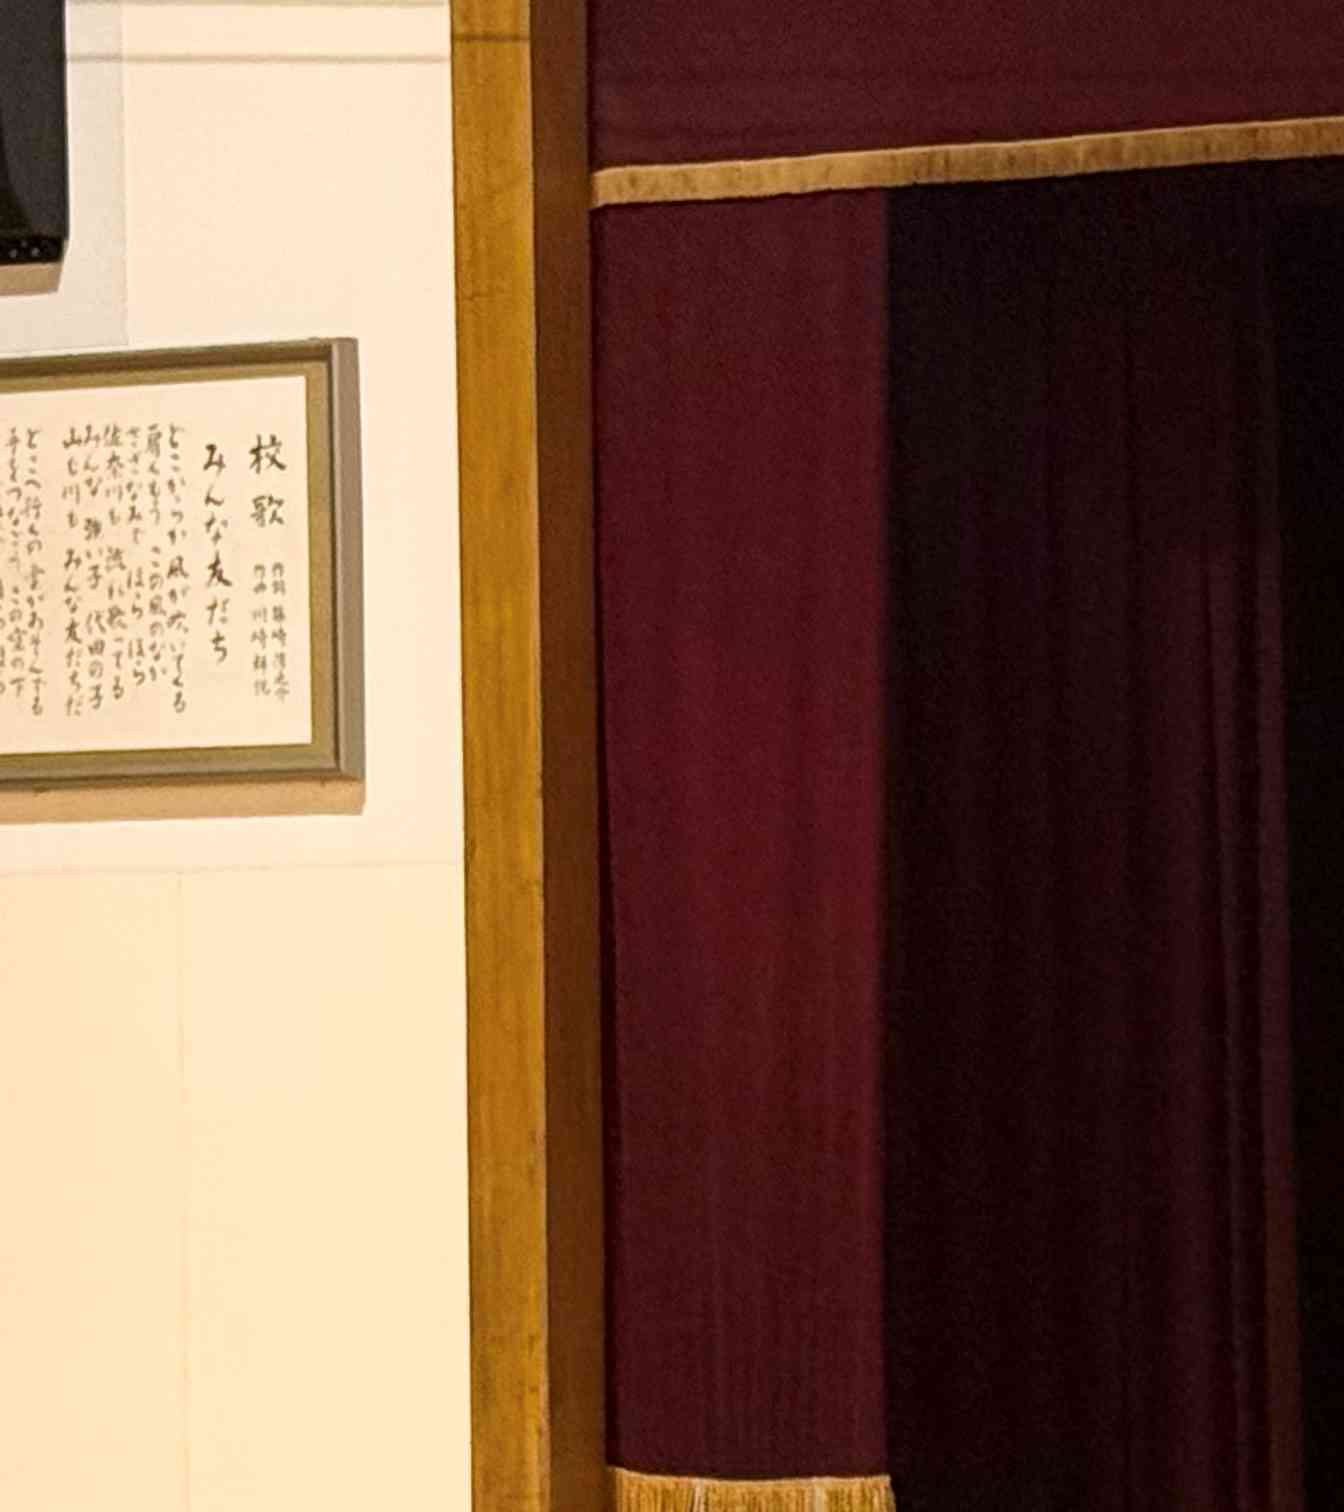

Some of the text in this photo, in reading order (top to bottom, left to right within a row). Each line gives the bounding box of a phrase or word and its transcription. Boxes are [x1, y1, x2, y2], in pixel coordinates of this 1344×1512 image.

[82, 423, 102, 497] みんな
[248, 434, 288, 528] 校歌
[61, 426, 84, 717] 山も川も みんな友だちだ
[202, 443, 233, 663] みんな友だち
